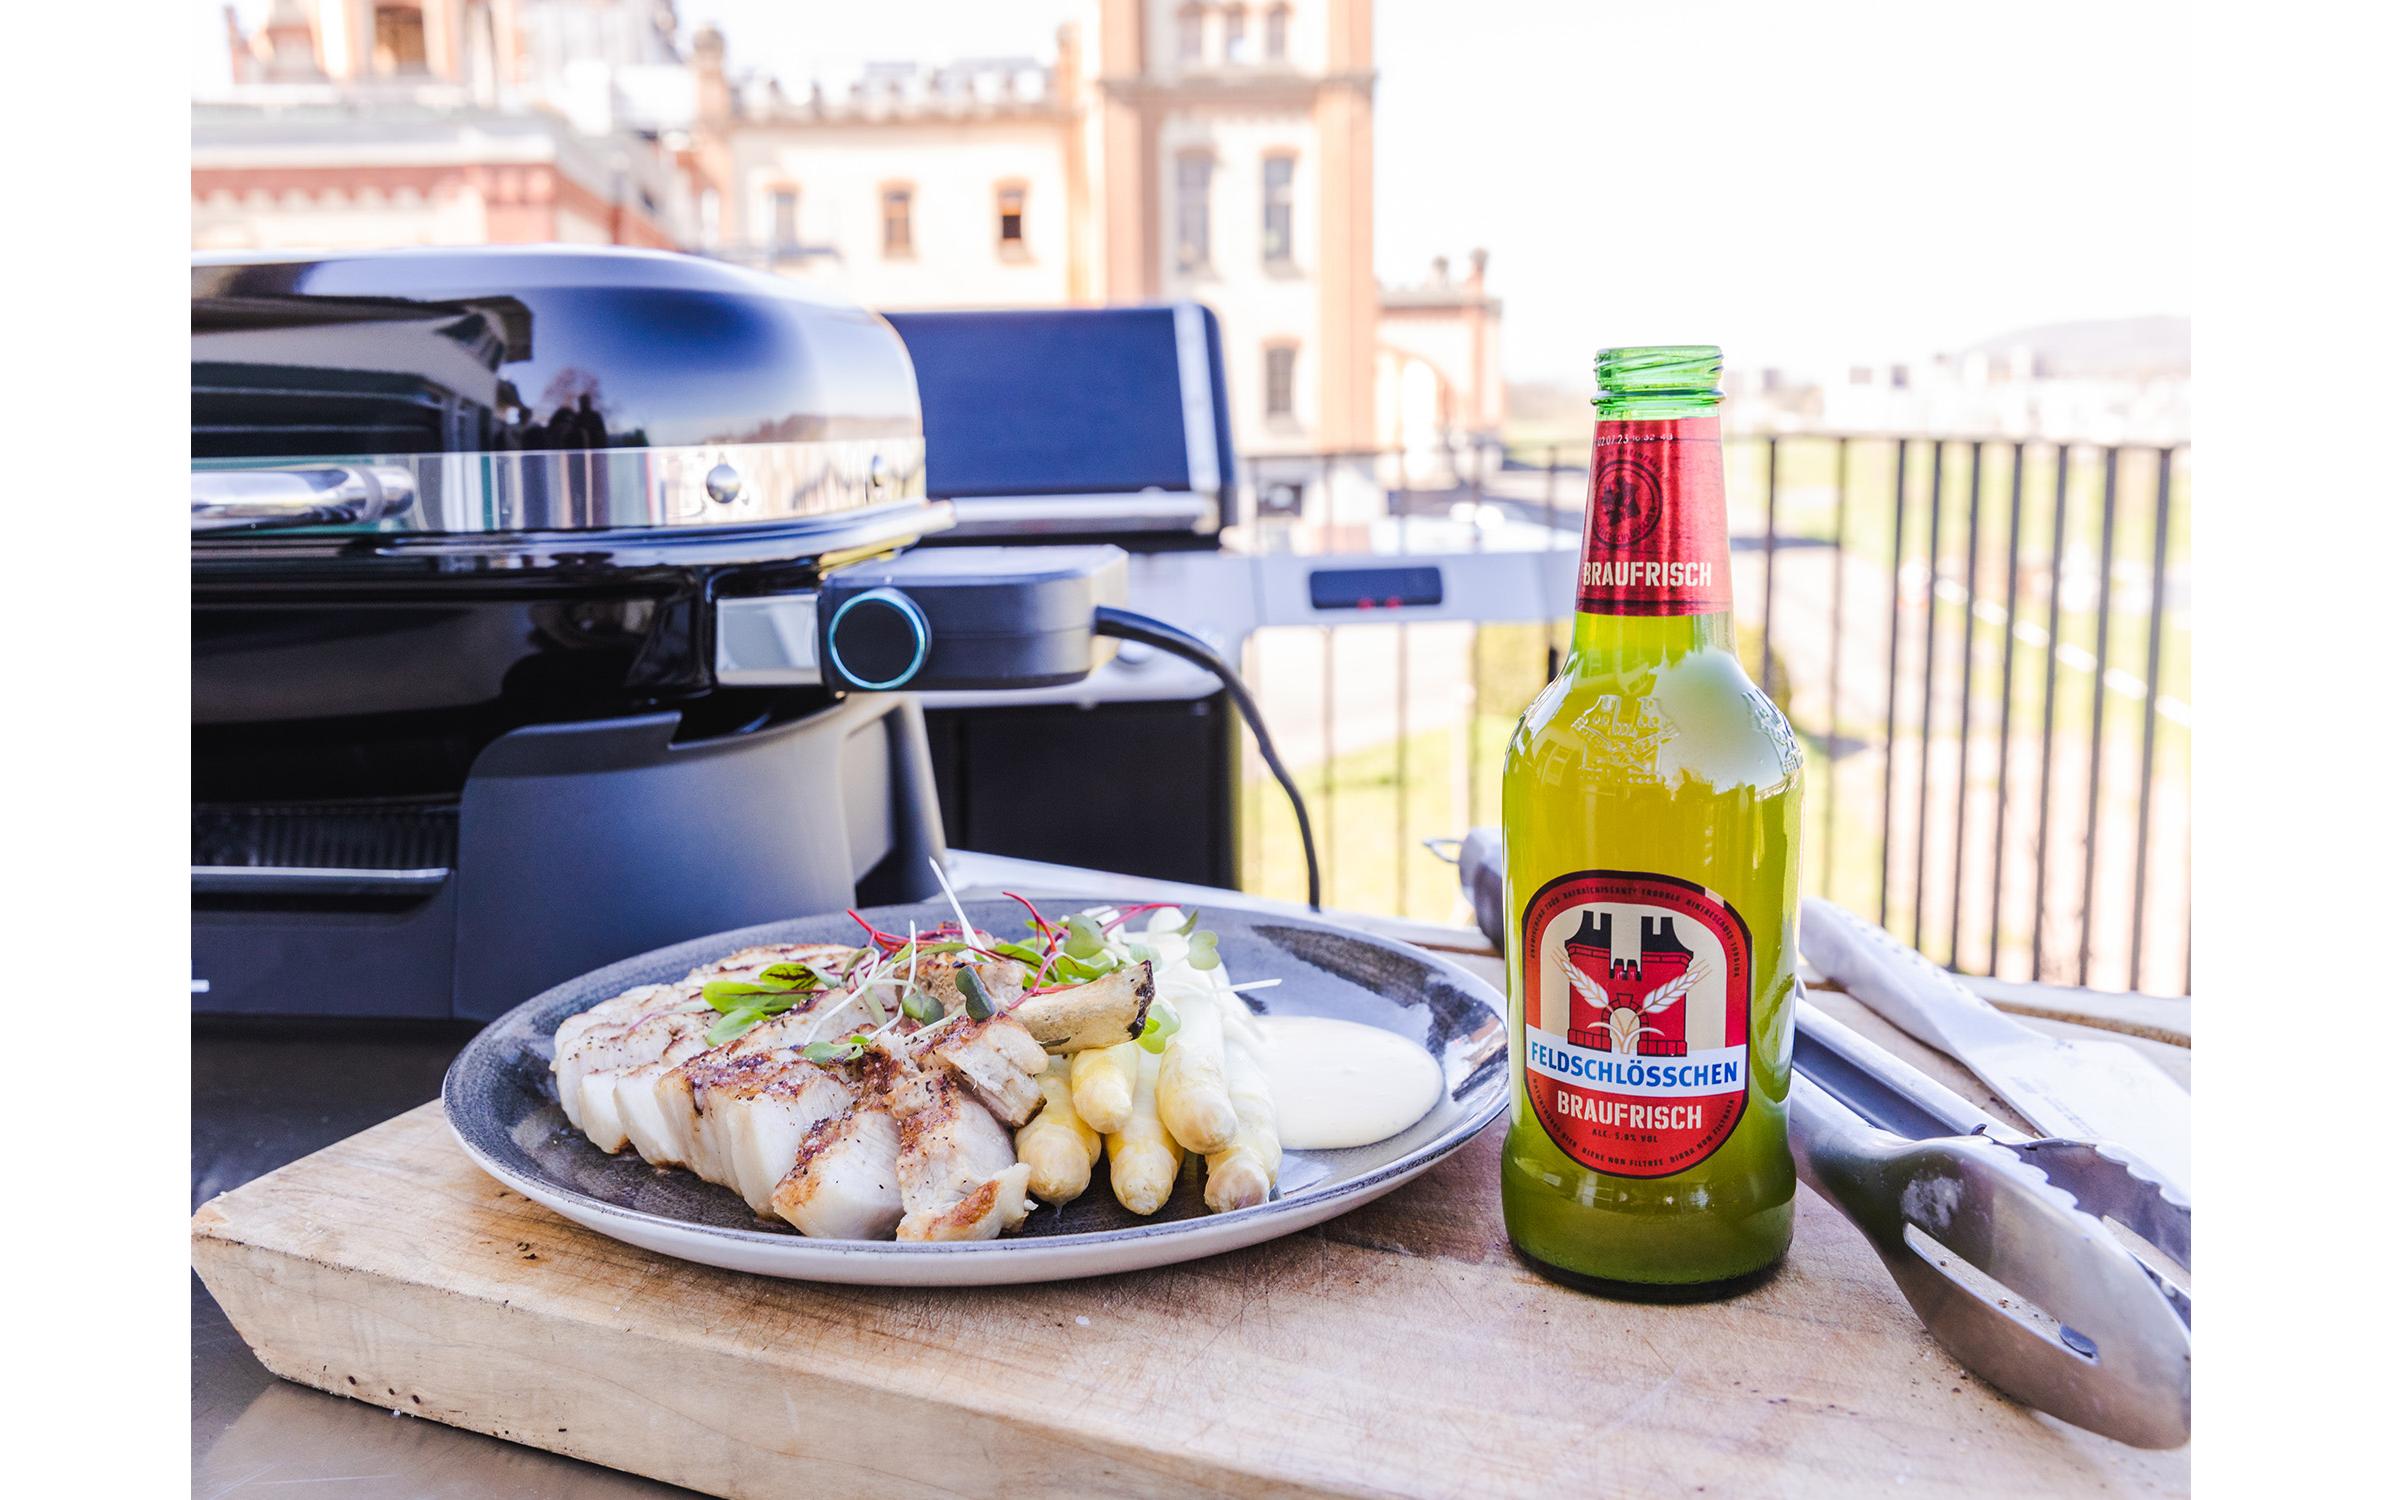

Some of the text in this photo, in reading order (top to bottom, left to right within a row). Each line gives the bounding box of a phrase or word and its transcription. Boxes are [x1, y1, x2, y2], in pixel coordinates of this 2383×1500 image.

[1583, 561, 1712, 587] BRAUFRISCH
[1531, 1040, 1738, 1088] FELDSCHLÖSSCHEN
[1557, 1090, 1702, 1130] BRAUFRISCH
